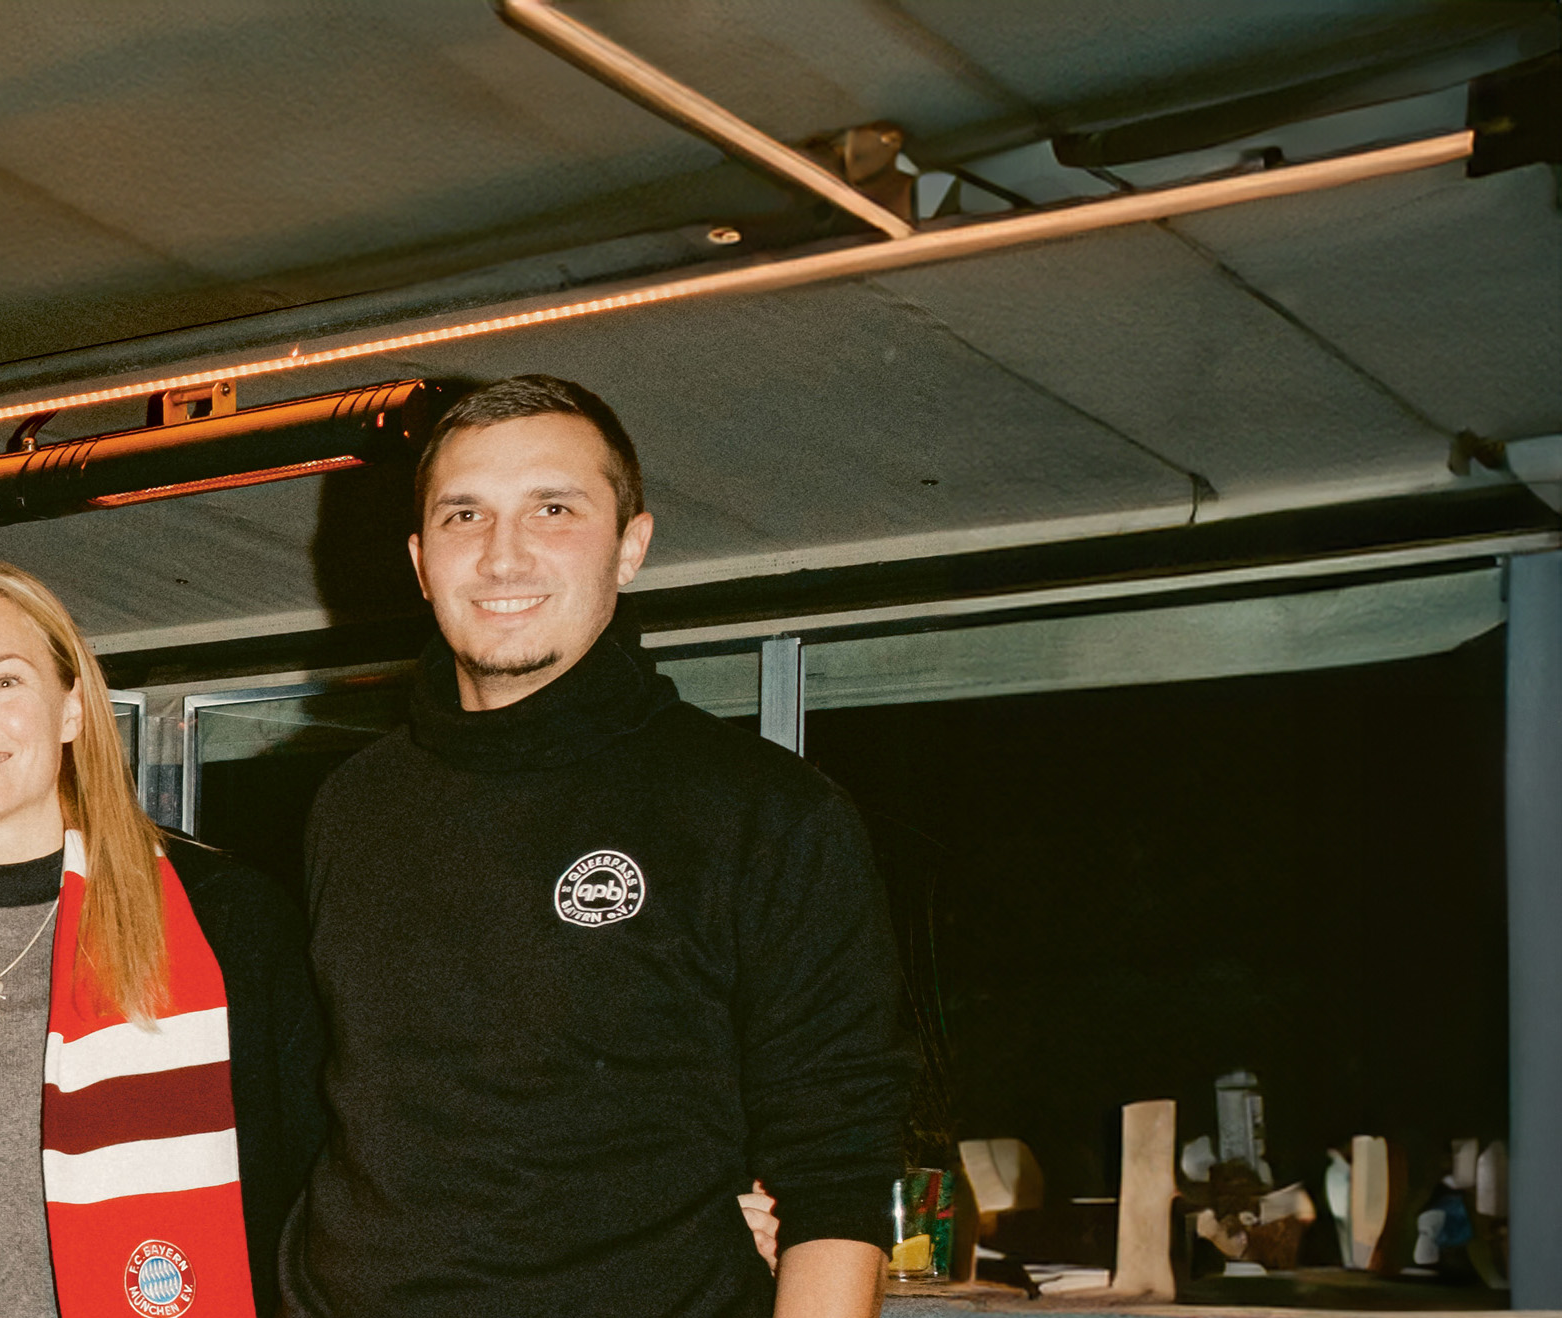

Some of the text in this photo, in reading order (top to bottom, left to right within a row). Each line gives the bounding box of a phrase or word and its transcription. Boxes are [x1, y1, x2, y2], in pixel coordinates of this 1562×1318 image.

[568, 856, 638, 886] QUEERPASS
[578, 880, 622, 902] qpb
[561, 900, 602, 923] BAYERN
